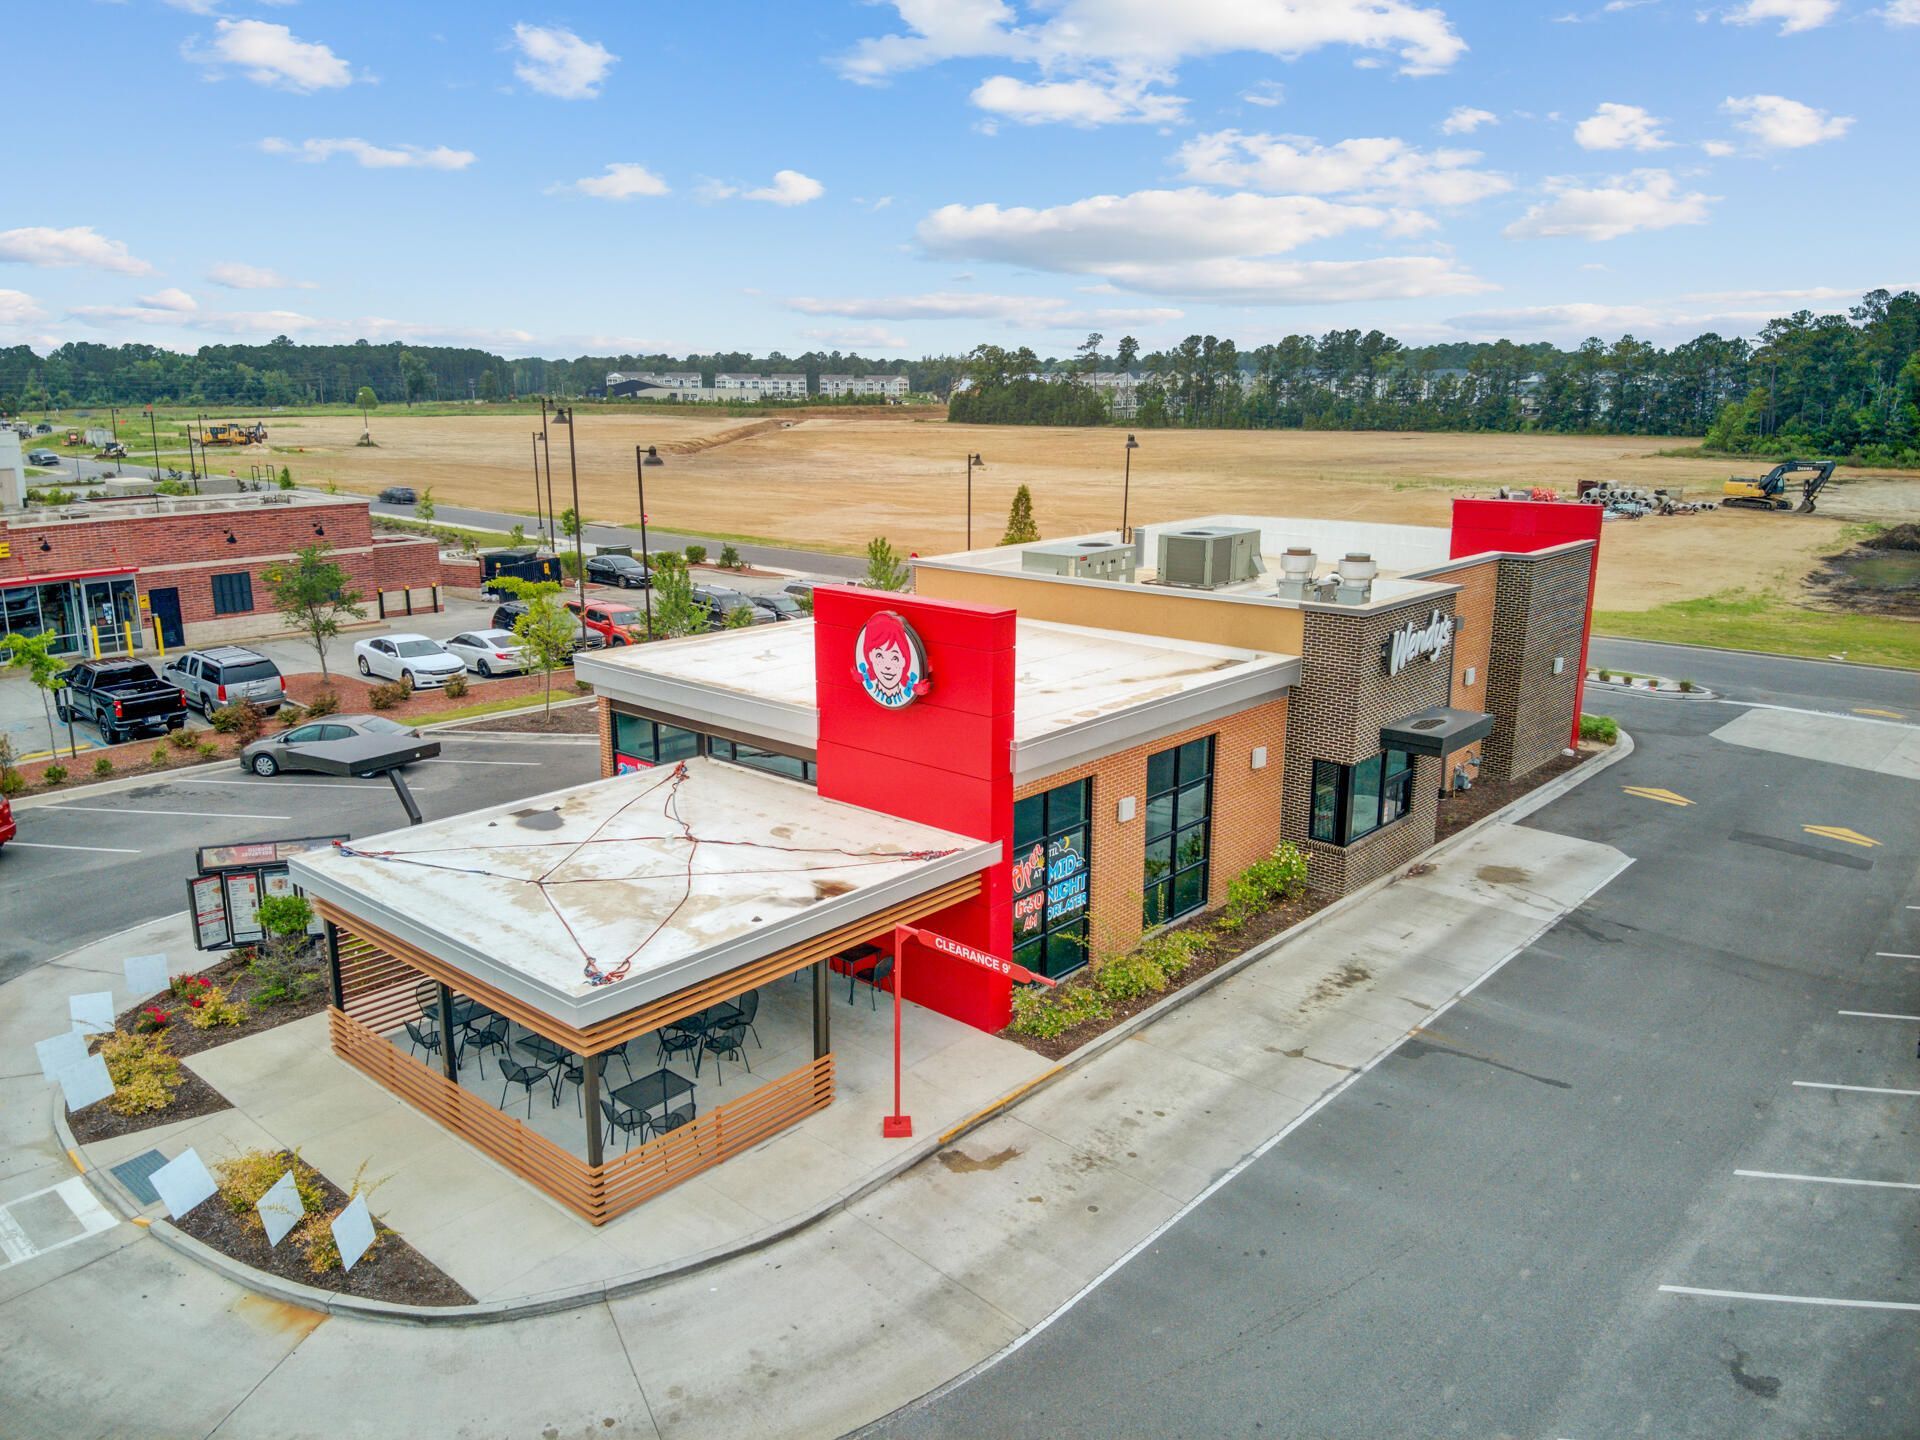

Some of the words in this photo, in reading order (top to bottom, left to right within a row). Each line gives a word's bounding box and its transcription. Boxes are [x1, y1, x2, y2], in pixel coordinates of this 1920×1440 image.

[1391, 609, 1452, 677] Wendy's
[1012, 844, 1044, 893] Open
[1047, 872, 1088, 906] NIGHT
[935, 937, 1000, 971] CLEARANCE
